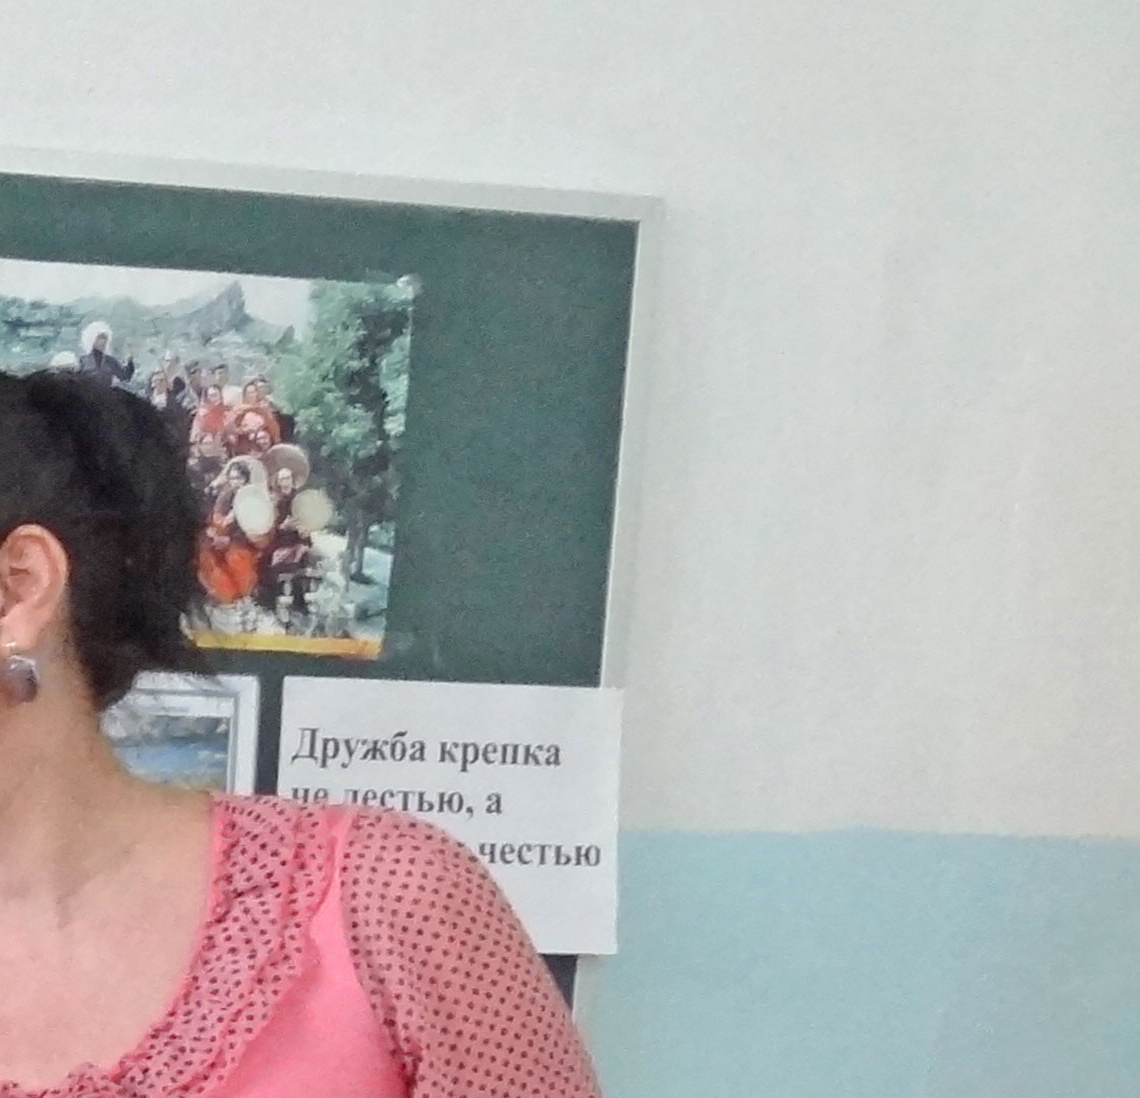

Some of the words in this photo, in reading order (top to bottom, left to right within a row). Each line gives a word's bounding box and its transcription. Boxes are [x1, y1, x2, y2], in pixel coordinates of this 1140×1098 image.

[291, 727, 426, 769] Дружба
[438, 740, 562, 773] крепка
[486, 793, 503, 814] а
[479, 840, 602, 867] честью
